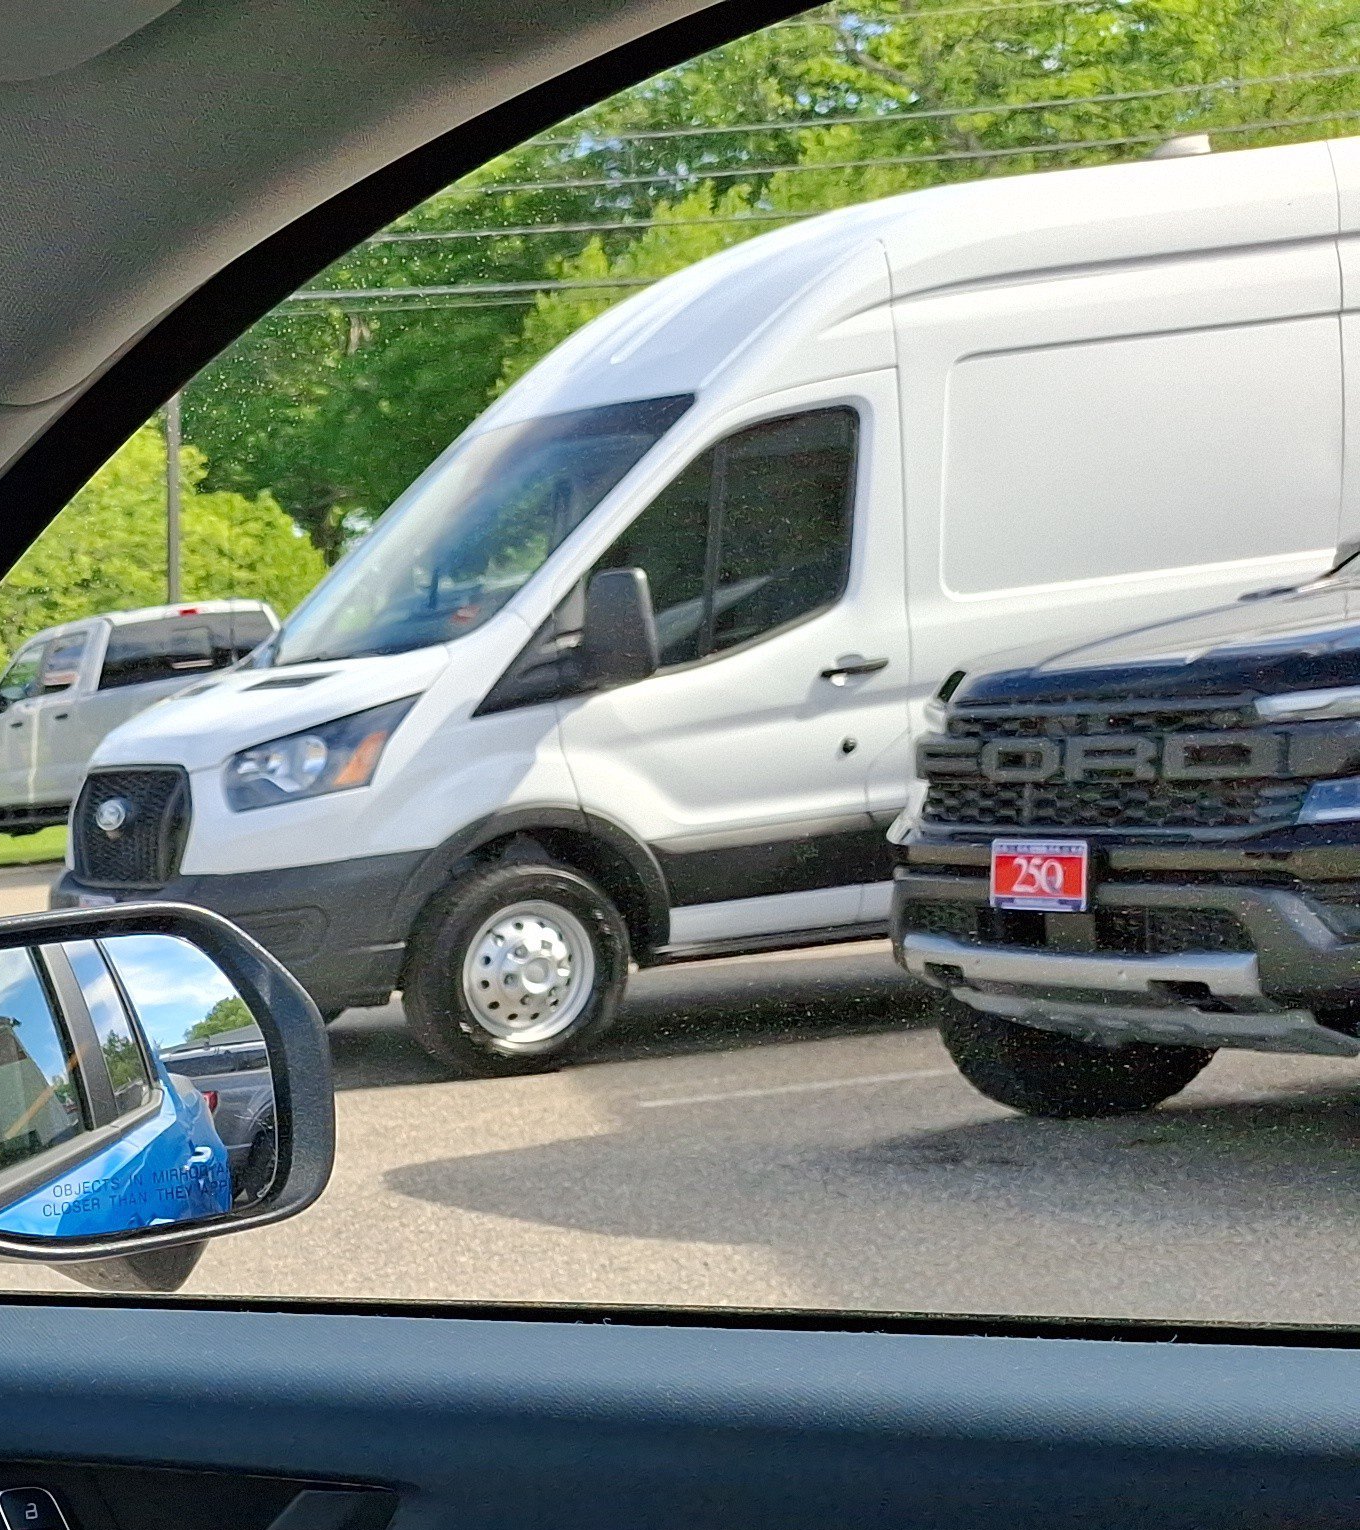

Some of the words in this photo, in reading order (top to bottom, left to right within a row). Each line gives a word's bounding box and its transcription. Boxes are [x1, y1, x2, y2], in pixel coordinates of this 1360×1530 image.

[52, 1176, 121, 1198] OBJECTS
[42, 1199, 101, 1217] CLOSER
[111, 1192, 147, 1207] THAN
[156, 1185, 193, 1200] THEY
